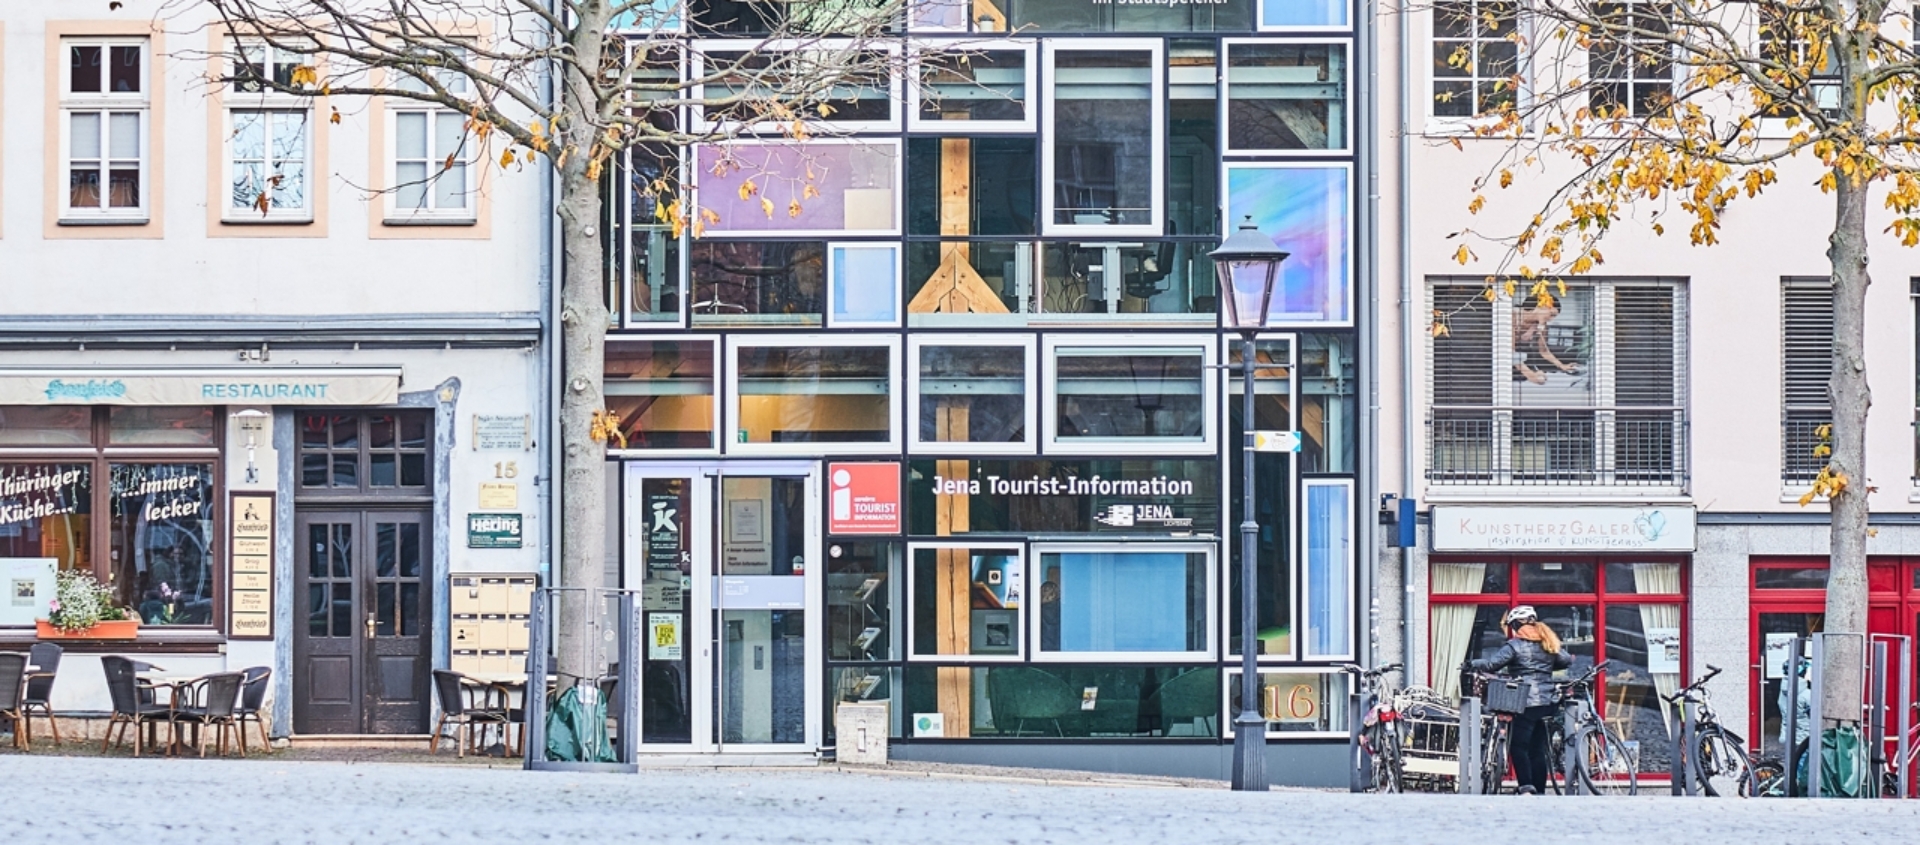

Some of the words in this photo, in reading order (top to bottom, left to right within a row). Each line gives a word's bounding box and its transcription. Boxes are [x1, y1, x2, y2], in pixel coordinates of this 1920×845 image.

[202, 384, 328, 398] RESTAURANT
[494, 461, 518, 478] 15
[932, 476, 981, 495] Jena
[987, 475, 1193, 495] Tourist-Information
[145, 499, 201, 522] lecker
[854, 503, 896, 513] TOURIST
[1137, 505, 1173, 518] JENA
[472, 517, 520, 534] Hering
[1264, 684, 1314, 718] 16
